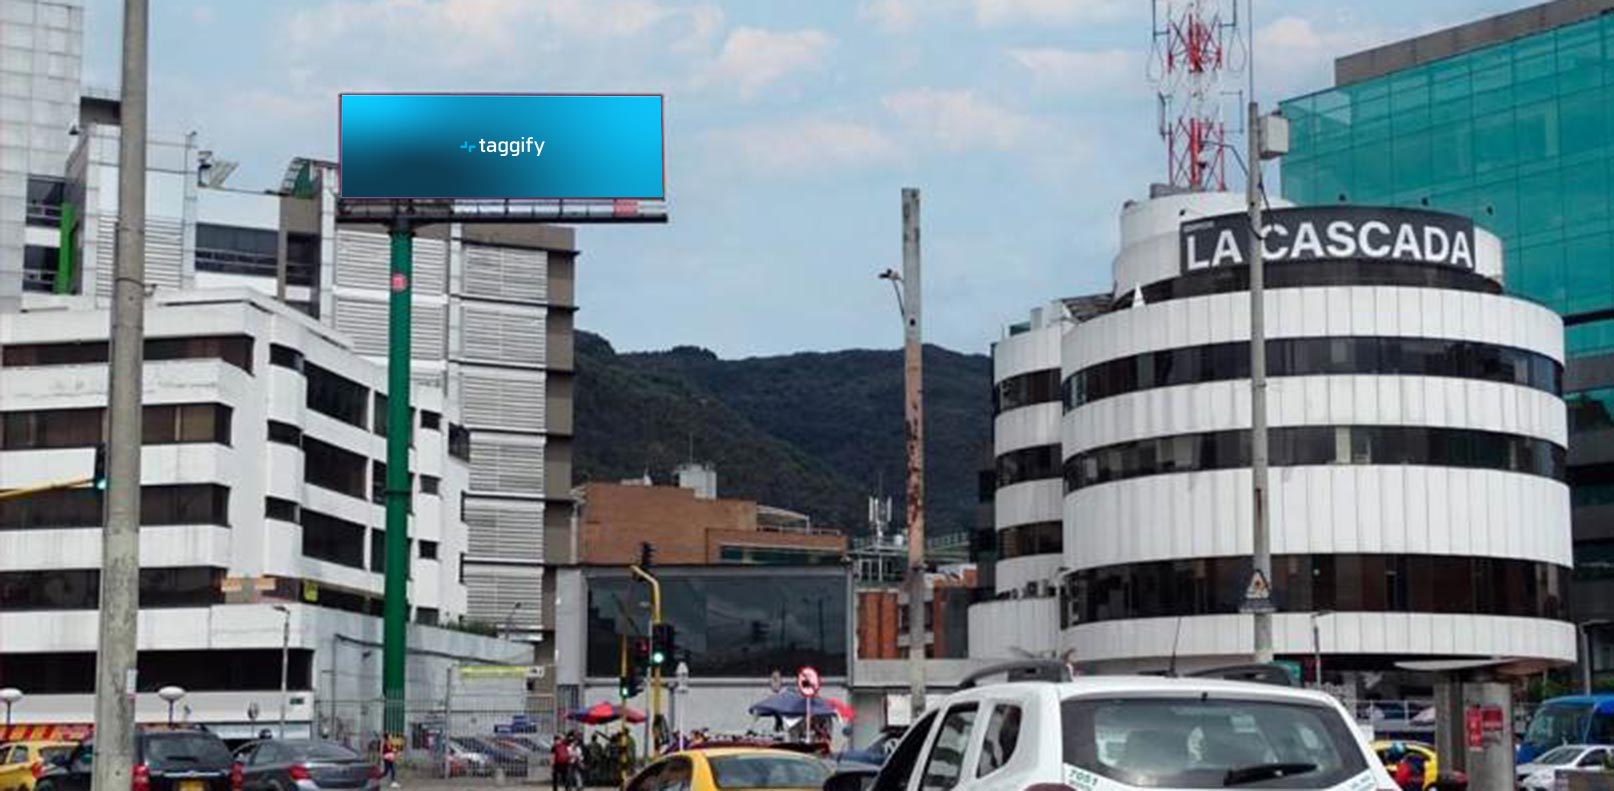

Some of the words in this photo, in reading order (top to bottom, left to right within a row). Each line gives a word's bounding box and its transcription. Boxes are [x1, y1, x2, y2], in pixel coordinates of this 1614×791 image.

[479, 136, 545, 157] taggify
[1187, 229, 1243, 270] LA
[1261, 220, 1473, 268] CASCADA
